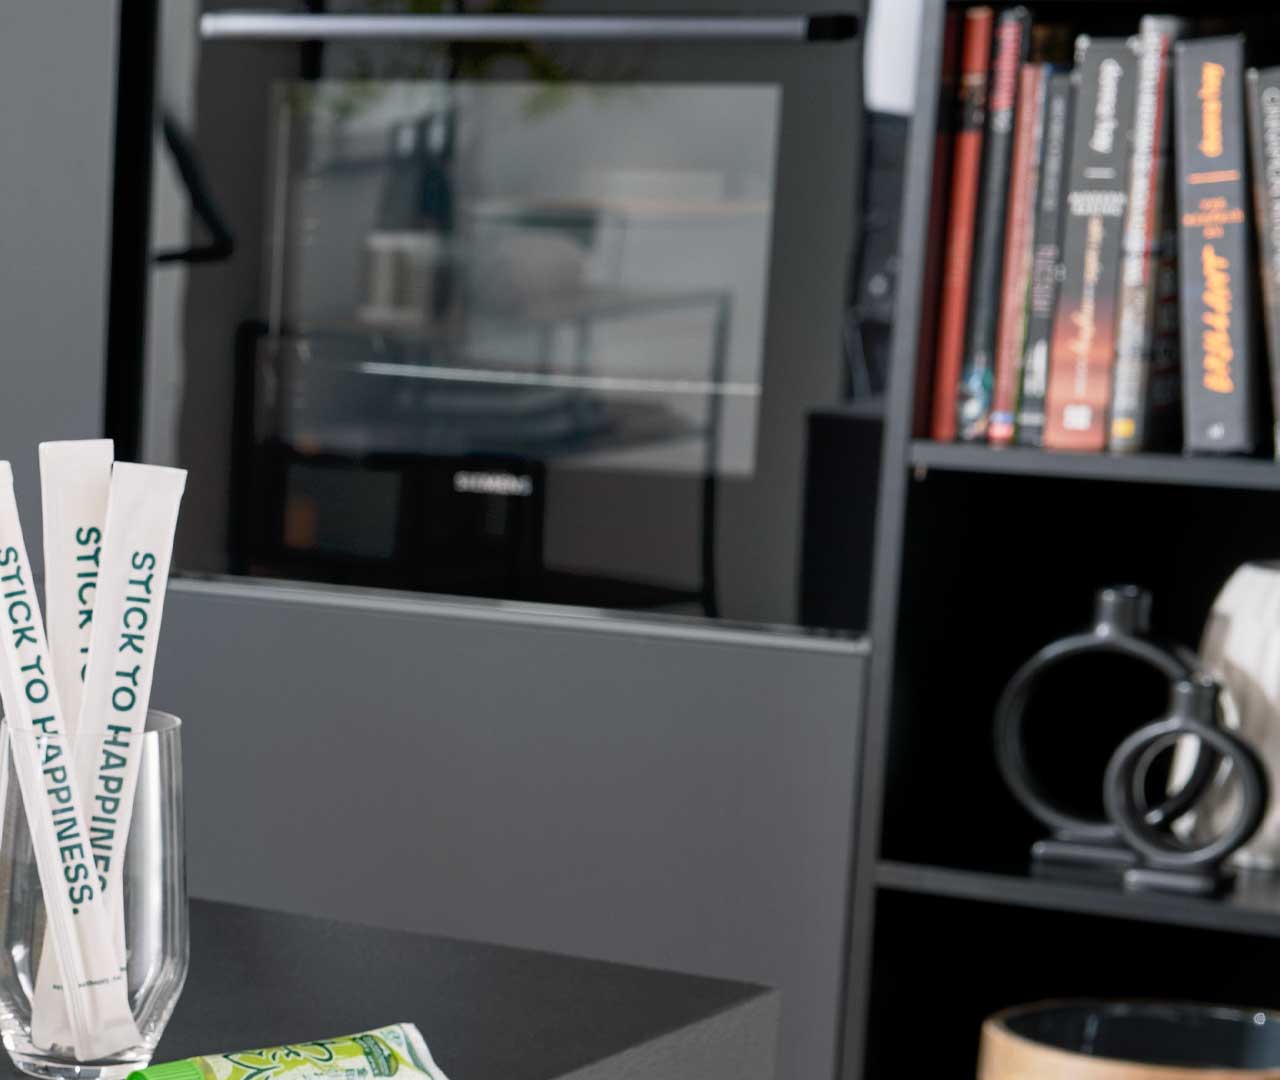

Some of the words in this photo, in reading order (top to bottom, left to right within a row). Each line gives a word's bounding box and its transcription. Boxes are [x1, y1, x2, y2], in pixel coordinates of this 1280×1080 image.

[119, 551, 156, 654] STICK
[21, 655, 49, 703] TO
[112, 665, 141, 711] TO
[32, 716, 93, 914] HAPPINESS.
